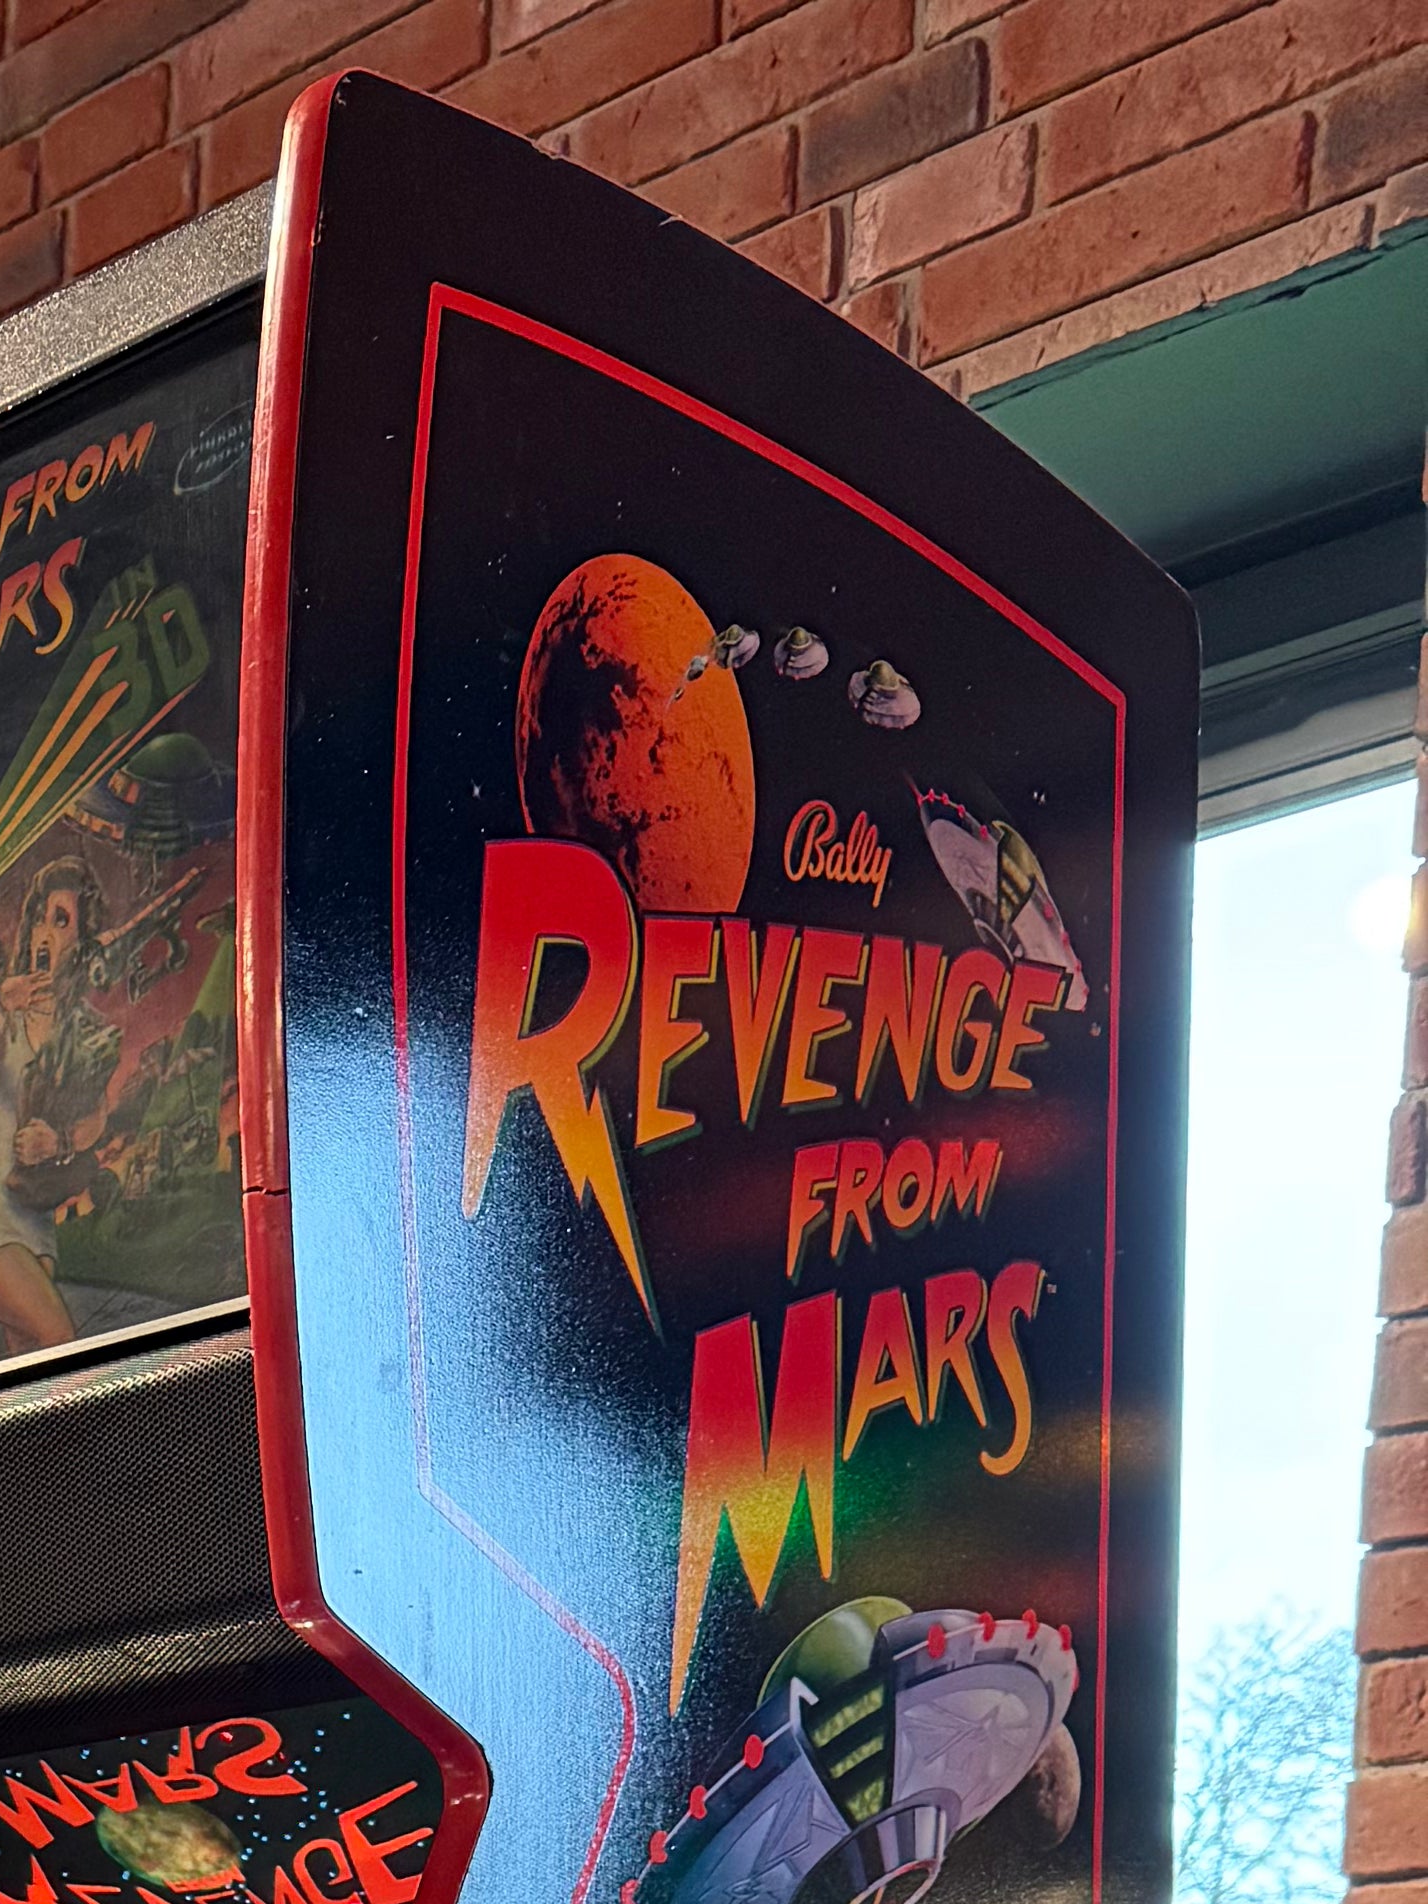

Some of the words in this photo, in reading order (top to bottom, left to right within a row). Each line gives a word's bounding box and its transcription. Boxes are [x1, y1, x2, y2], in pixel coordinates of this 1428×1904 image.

[784, 800, 894, 907] Bally
[460, 839, 1070, 1343] REVENGE
[787, 1137, 1005, 1285] FROM
[669, 1260, 1048, 1719] MARS
